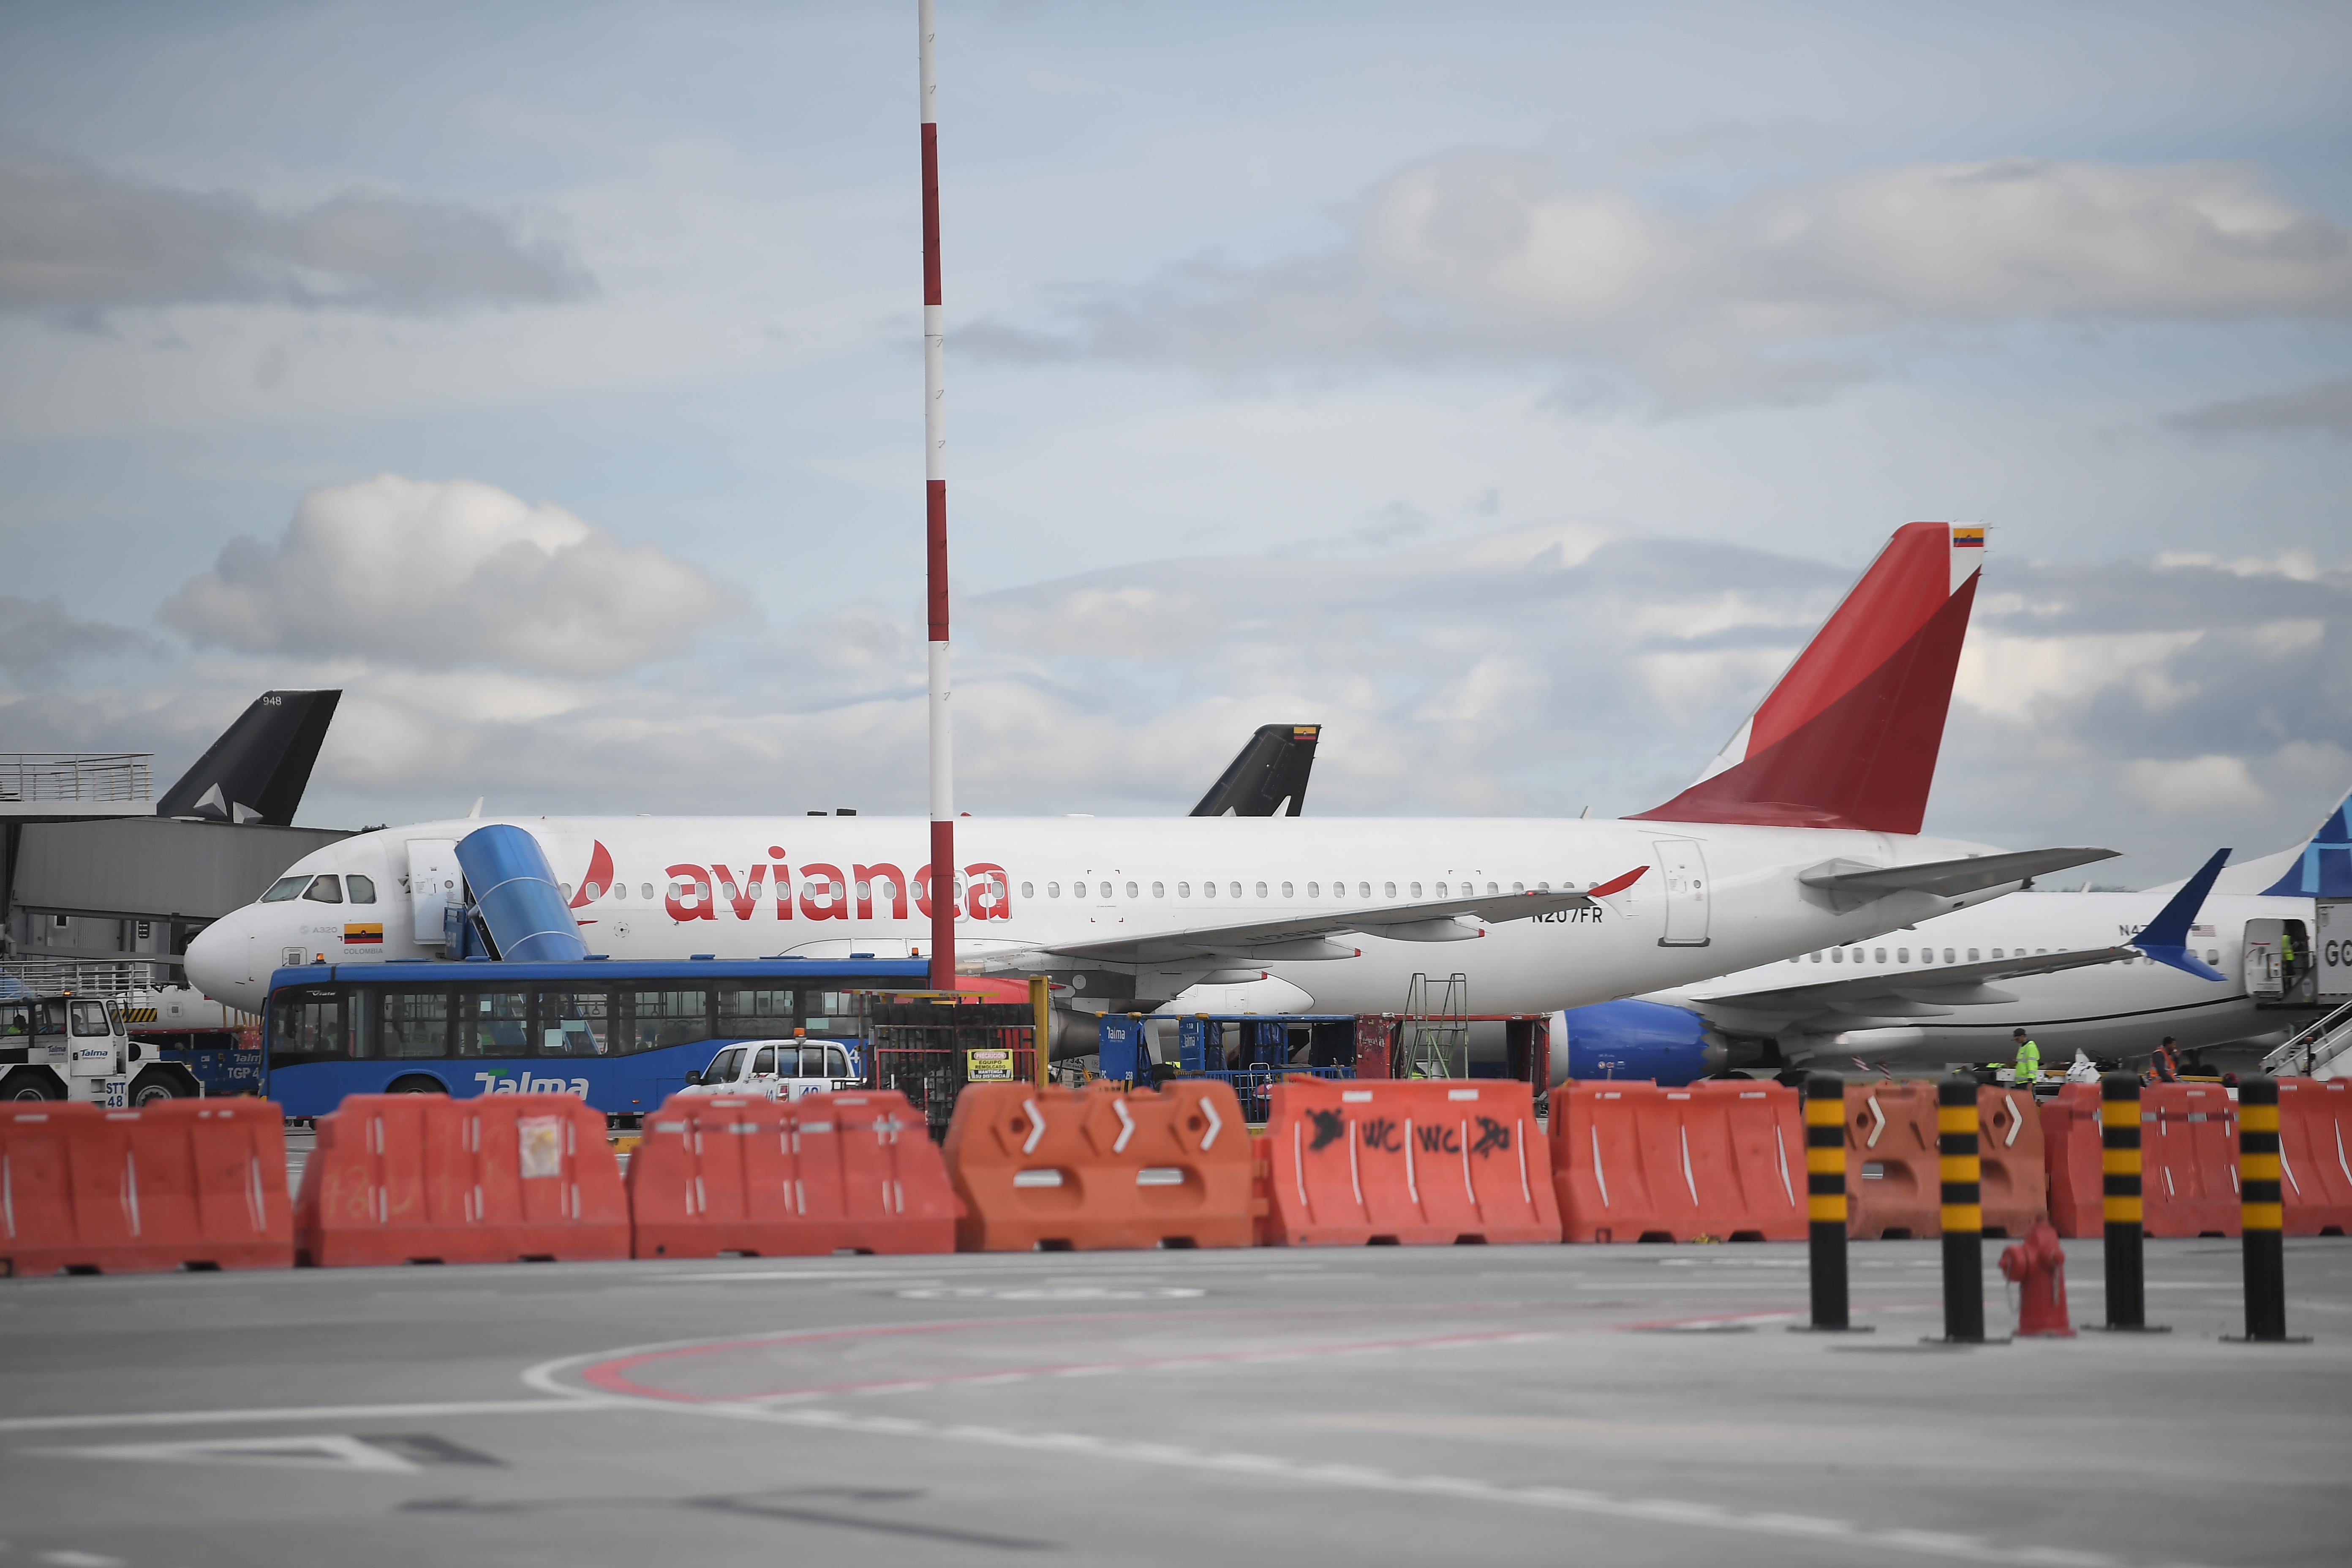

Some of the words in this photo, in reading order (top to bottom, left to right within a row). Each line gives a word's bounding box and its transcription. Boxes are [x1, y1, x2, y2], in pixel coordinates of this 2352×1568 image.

[263, 696, 282, 705] 948
[664, 846, 1013, 921] avianca
[2119, 924, 2148, 936] N4
[1107, 1026, 1126, 1040] Talma
[228, 1067, 250, 1079] TGP
[106, 1082, 125, 1094] STT
[474, 1068, 589, 1101] Talma
[108, 1095, 123, 1107] 48
[1362, 1117, 1401, 1152] WC
[1417, 1125, 1460, 1154] WC
